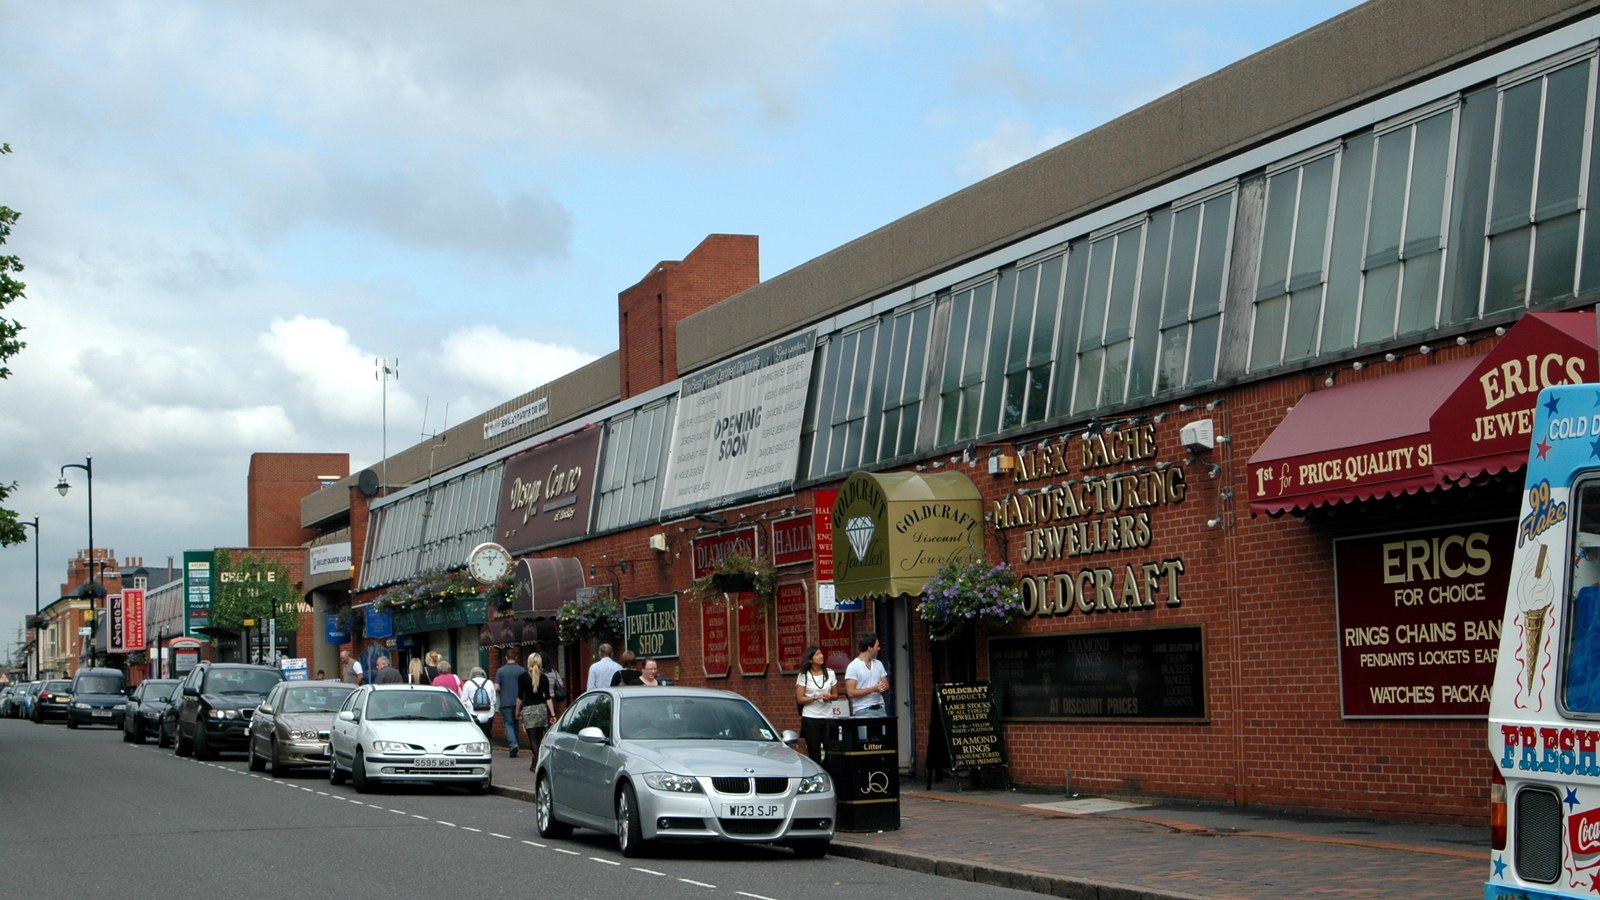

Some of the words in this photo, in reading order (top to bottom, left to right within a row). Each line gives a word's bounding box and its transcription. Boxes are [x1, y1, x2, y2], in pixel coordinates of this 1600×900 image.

[1480, 353, 1585, 410] ERICS
[714, 406, 763, 441] OPENING
[1472, 408, 1536, 442] JEWE
[1549, 415, 1588, 441] COLD
[1592, 414, 1600, 436] D
[718, 433, 750, 462] SOON
[1014, 442, 1069, 483] ALEX
[1080, 424, 1157, 471] BACHE
[1256, 466, 1273, 497] 1st
[1279, 462, 1293, 495] for
[1299, 459, 1342, 486] PRICE
[1345, 447, 1414, 482] QUALITY
[833, 478, 886, 529] GOLDCRAFT
[992, 467, 1186, 529] MANUFACTURING
[1529, 480, 1550, 513] 99
[815, 507, 832, 515] HAL
[895, 504, 978, 534] GOLDCRAFT
[1519, 500, 1566, 548] Flake
[912, 531, 963, 543] Discount
[1021, 512, 1152, 563] JEWELLERS
[900, 546, 977, 571] Jewelles
[1382, 532, 1492, 584] ERICS
[1018, 557, 1184, 617] OLDCRAFT
[1394, 588, 1424, 607] FOR
[1428, 583, 1486, 604] CHOICE
[126, 593, 136, 618] Adams
[646, 603, 654, 612] THE
[127, 619, 137, 647] Harvey
[627, 609, 676, 641] JEWELLERS
[1345, 626, 1390, 647] RINGS
[1395, 622, 1457, 644] CHAINS
[1464, 619, 1504, 641] BAN
[639, 633, 664, 655] SHOP
[1067, 637, 1110, 652] DIAMOND
[1075, 653, 1102, 667] RINGS
[1360, 652, 1415, 667] PENDANTS
[1419, 650, 1470, 665] LOCKETS
[1475, 648, 1499, 664] EAR
[941, 686, 988, 695] GOLDCRAFT
[946, 692, 987, 701] PRODUCTS
[1369, 685, 1435, 704] WATCHES
[945, 703, 966, 711] LARGE
[952, 713, 988, 721] JEWELLERY
[1050, 698, 1059, 714] AT
[1063, 698, 1104, 714] DISCOUNT
[1107, 698, 1139, 715] PRICES
[863, 743, 883, 751] Litter
[952, 735, 997, 746] DIAMOND
[962, 744, 991, 754] RINGS
[1501, 724, 1600, 777] FRESH
[414, 759, 437, 767] S595
[955, 751, 1000, 760] MANUFACTURED
[860, 771, 889, 794] JQ
[757, 805, 778, 817] SJP
[1578, 817, 1600, 851] Coca-
